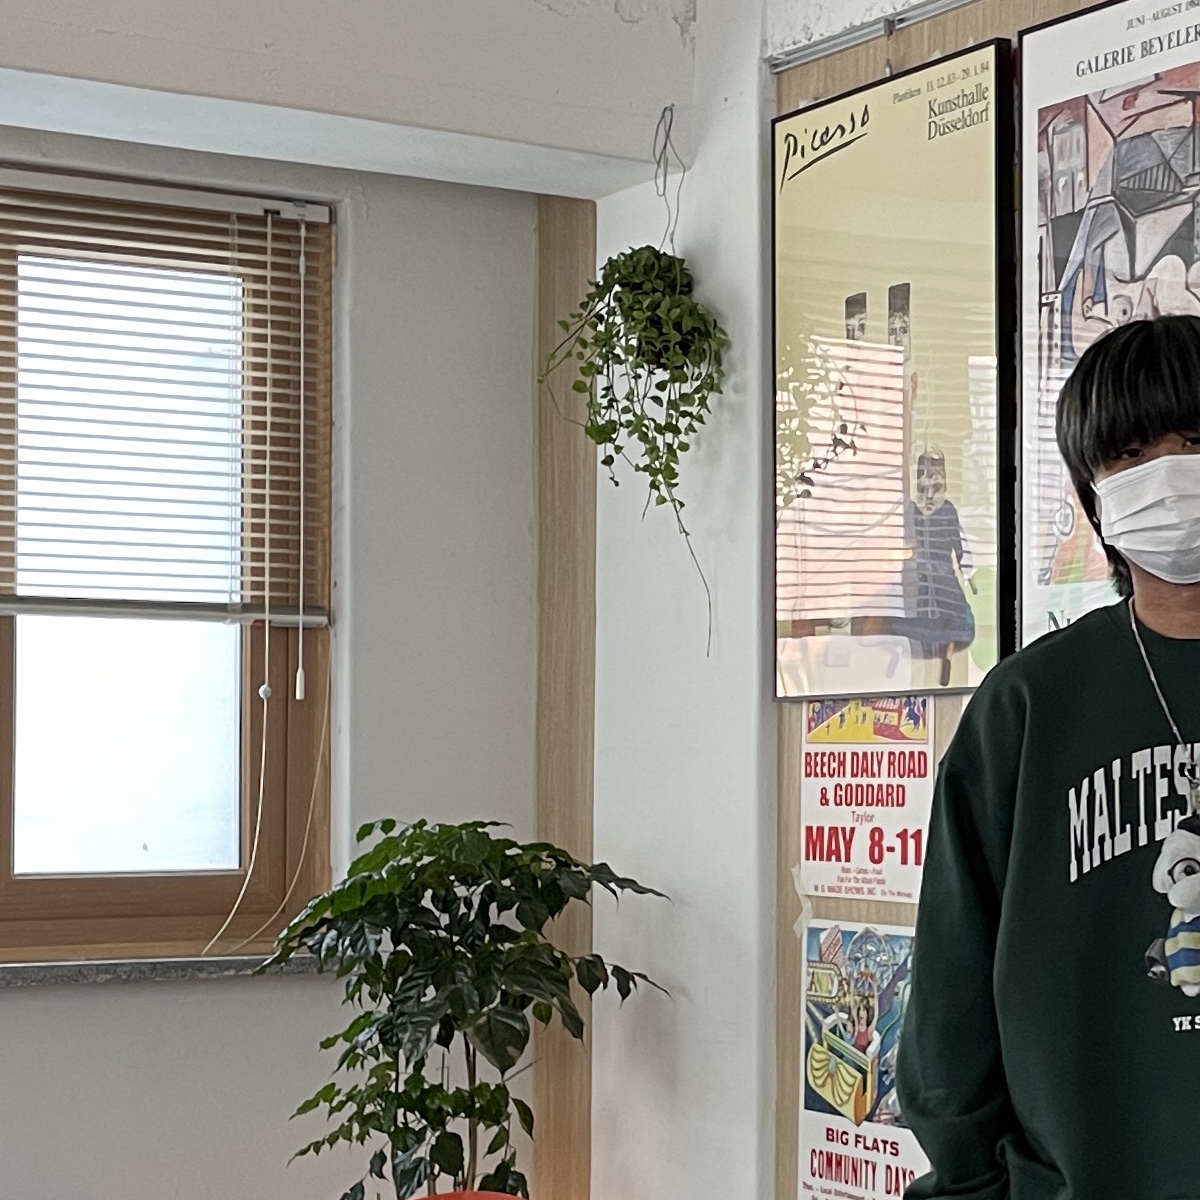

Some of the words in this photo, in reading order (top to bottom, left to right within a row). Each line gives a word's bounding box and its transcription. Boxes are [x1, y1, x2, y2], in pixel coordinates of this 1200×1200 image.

[1076, 44, 1135, 77] GALERIE
[928, 83, 989, 119] Kunsthalle
[928, 101, 990, 140] Düsseldorf
[779, 104, 869, 194] Picasso
[805, 751, 846, 778] BEECH
[850, 751, 884, 779] DALY
[888, 751, 928, 779] ROAD
[820, 786, 830, 806] &
[834, 783, 906, 808] GODDARD
[851, 811, 874, 826] Taylor
[805, 825, 856, 863] MAY
[869, 826, 922, 866] 8-11
[1172, 1016, 1192, 1031] YK
[826, 1127, 849, 1146] BIG
[855, 1133, 899, 1157] FLATS
[810, 1148, 877, 1191] COMMUNITY
